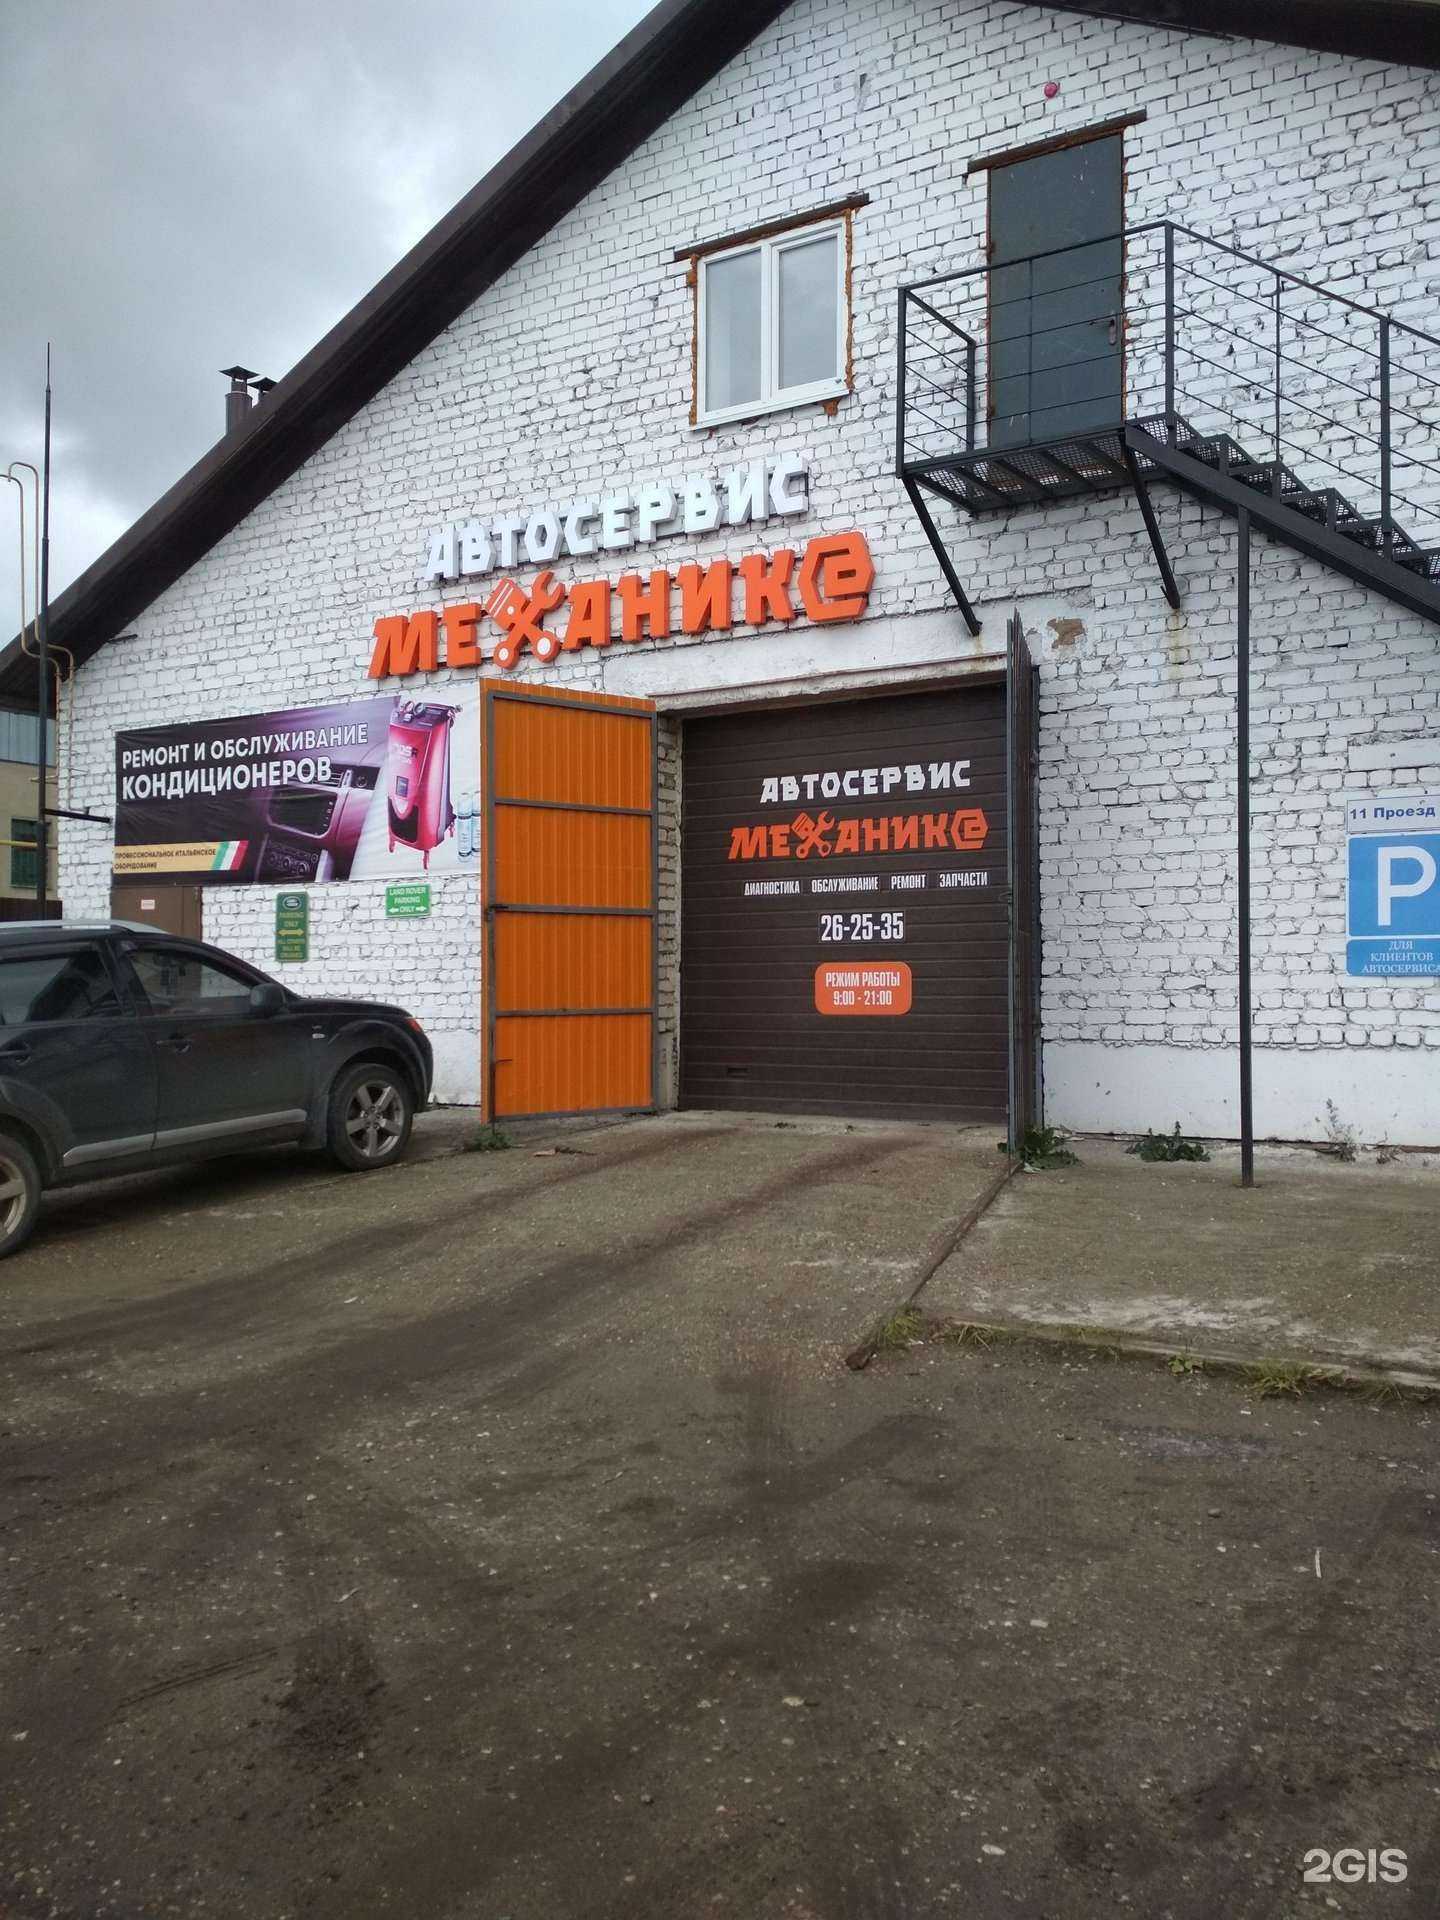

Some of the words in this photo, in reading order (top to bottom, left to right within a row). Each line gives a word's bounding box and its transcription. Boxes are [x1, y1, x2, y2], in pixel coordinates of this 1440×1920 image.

[424, 452, 810, 582] АВТОСЕРВИС
[122, 744, 189, 769] РЕМОНТ
[194, 742, 205, 761] И
[212, 723, 368, 760] ОБСЛУЖИВАНИЕ
[122, 756, 332, 800] КОНДИЦИОНЕРОВ
[760, 760, 971, 803] АВТОСЕРВИС
[1350, 808, 1367, 820] 11
[1374, 806, 1436, 820] Проезд
[115, 850, 174, 859] ПРОФЕССИОНАЛЬНОЕ
[175, 849, 216, 857] ИТАЛЬЯНСКОЕ
[114, 862, 157, 870] ОБОРУДОВАНИЕ
[744, 880, 800, 896] ДИАГНОСТИКА
[811, 876, 879, 893] ОБСЛУЖИВАНИЕ
[891, 874, 926, 890] РЕМОНТ
[939, 871, 988, 888] ЗАПЧАСТИ
[1377, 846, 1437, 926] P
[821, 912, 904, 941] 26-25-35
[1389, 940, 1413, 951] ДЛЯ
[1370, 952, 1433, 962] КЛИЕНТОВ
[825, 972, 860, 987] РЕЖИМ
[862, 971, 900, 986] РАБОТЫ
[833, 990, 855, 1005] 9:00
[864, 990, 892, 1005] 21:00
